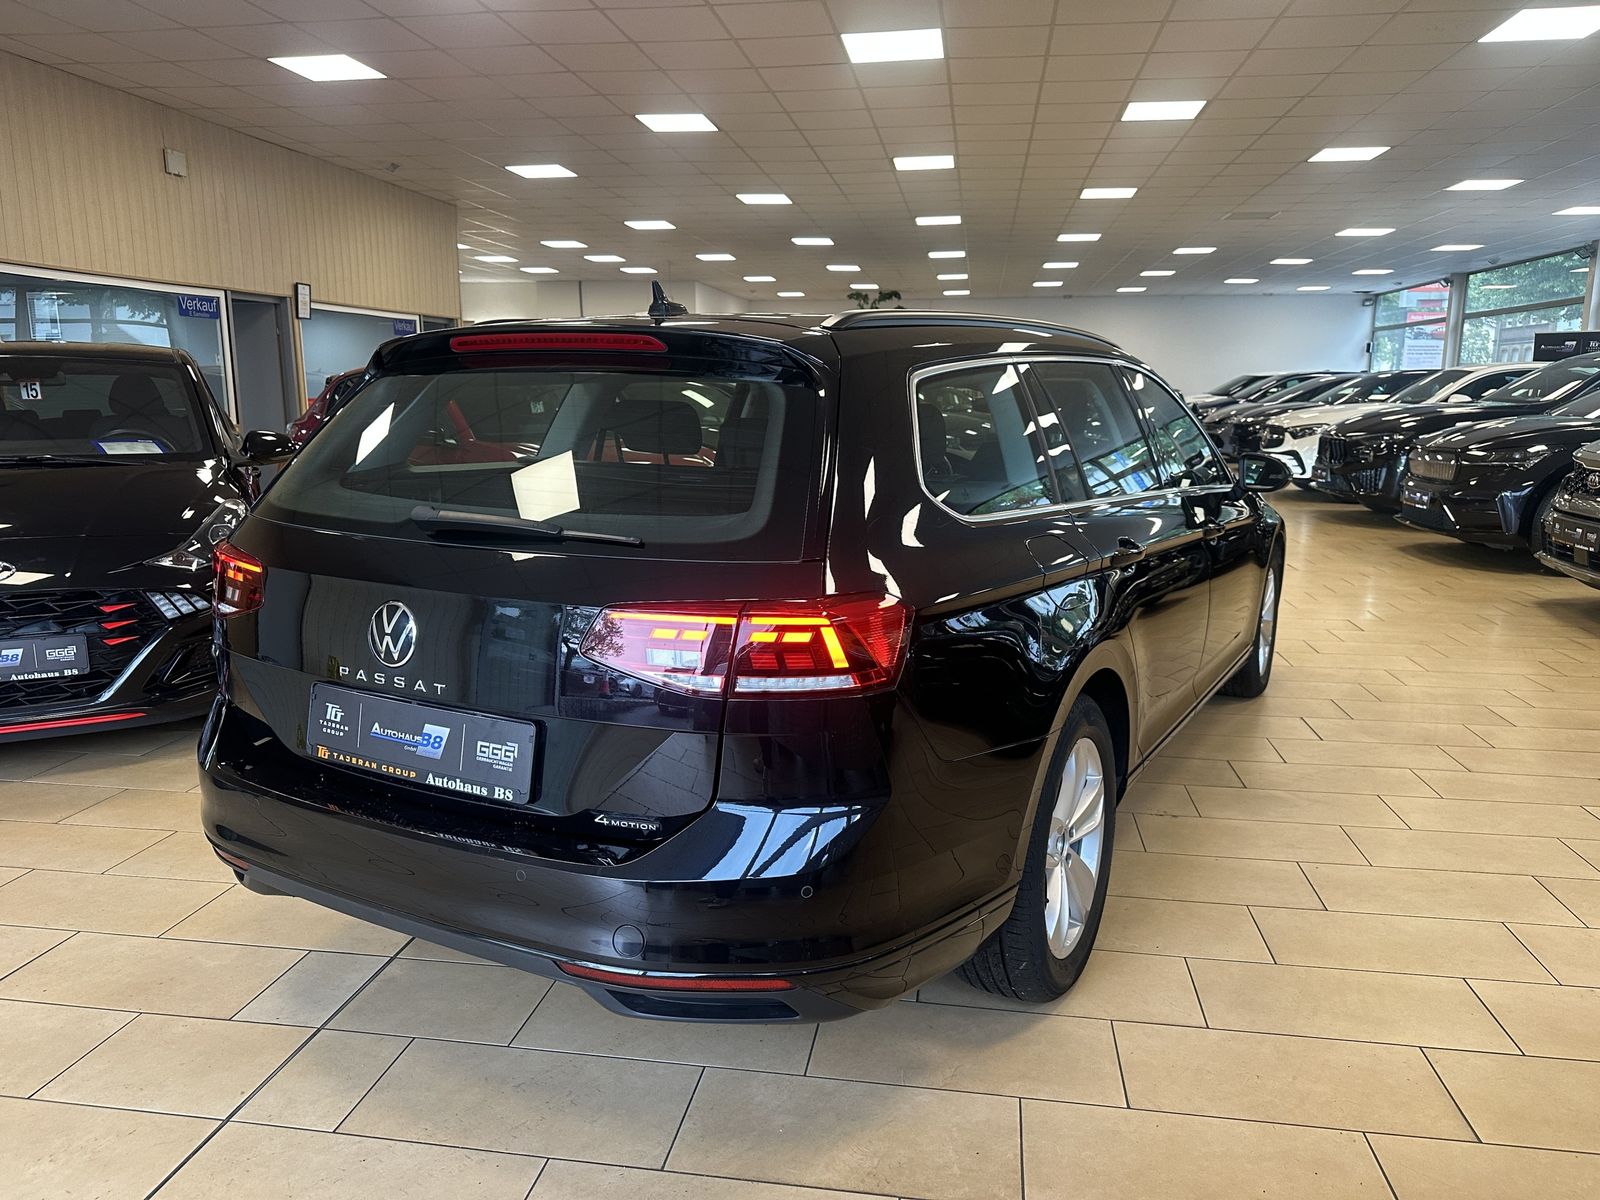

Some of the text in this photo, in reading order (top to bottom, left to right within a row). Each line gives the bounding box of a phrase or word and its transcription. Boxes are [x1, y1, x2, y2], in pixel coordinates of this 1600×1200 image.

[179, 296, 218, 312] Verkauf
[23, 383, 39, 399] 15
[10, 671, 60, 681] Autohaus
[339, 666, 446, 695] PASSAT
[322, 727, 344, 737] GROUP
[477, 740, 515, 762] GGG
[333, 752, 377, 769] TAJERAN
[381, 765, 417, 778] GROUP
[425, 772, 514, 802] Autohaus B8
[594, 814, 657, 831] 4MOTION
